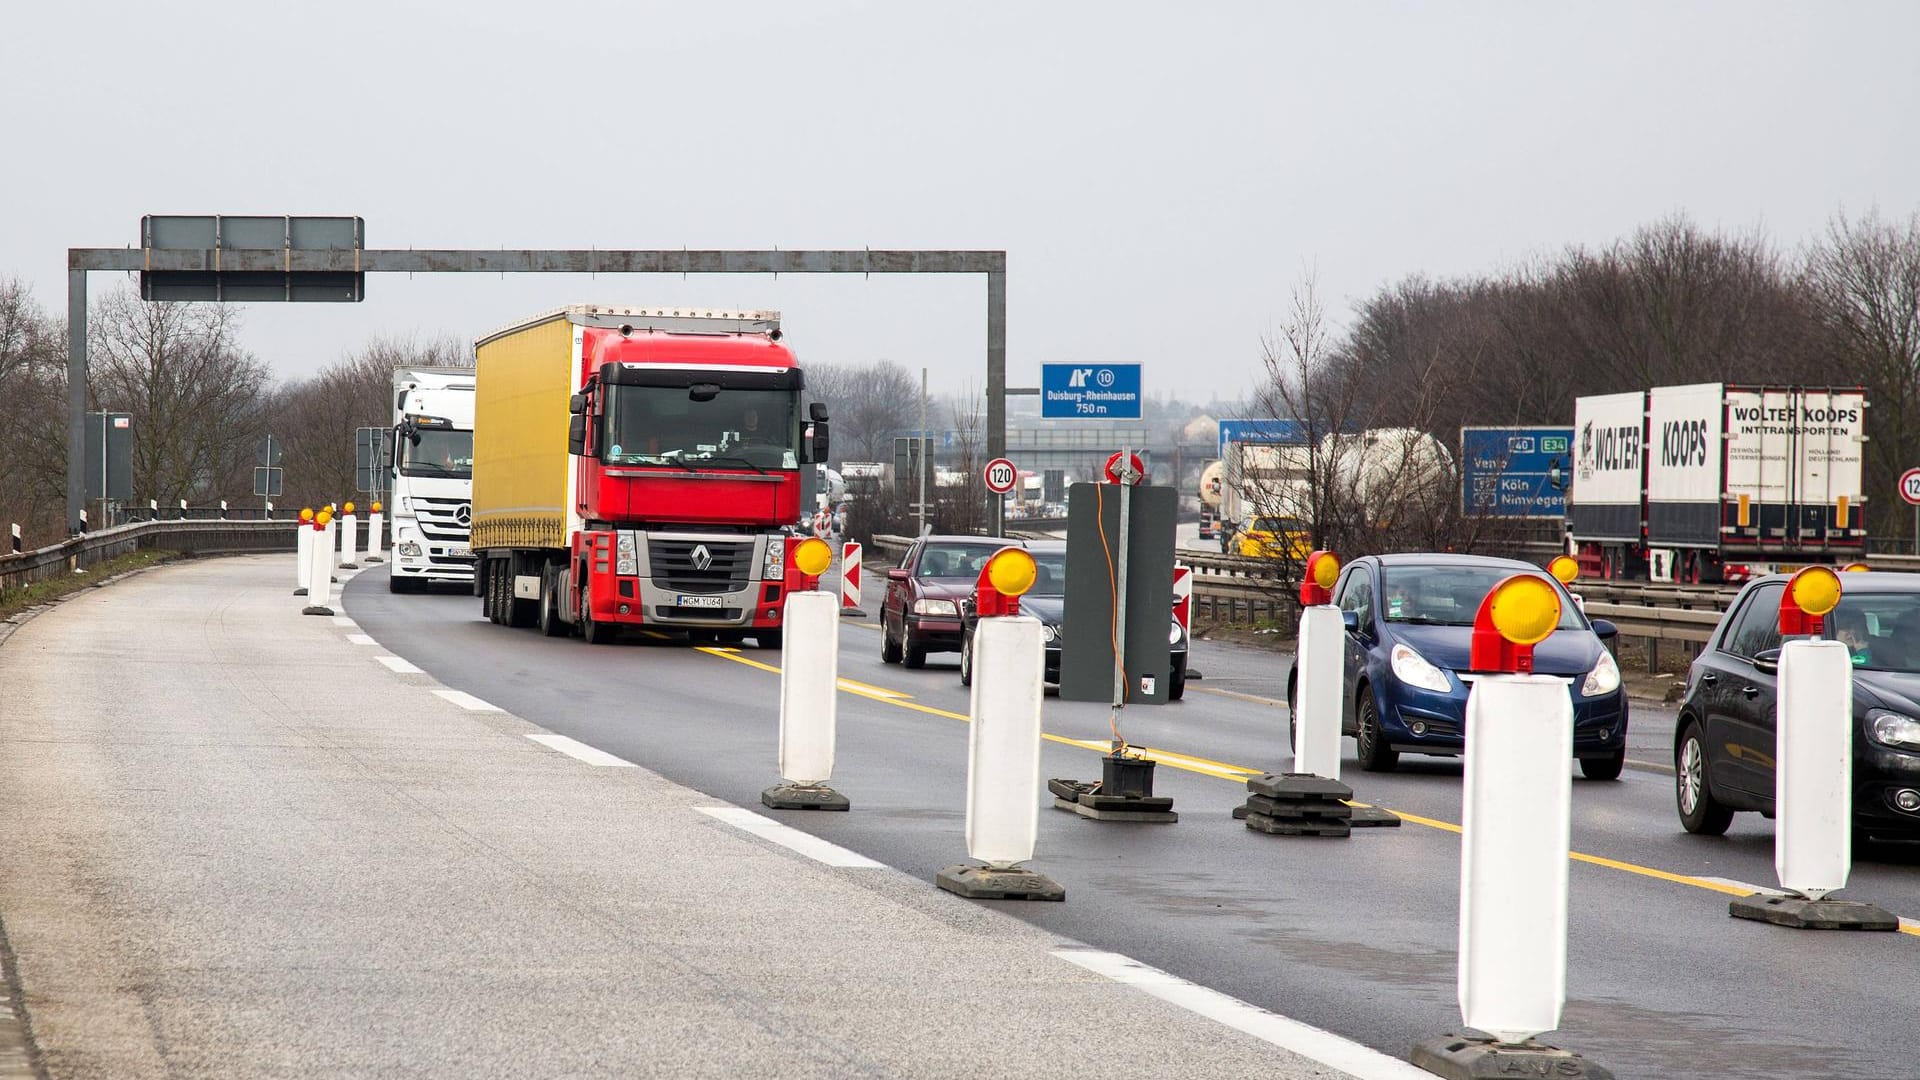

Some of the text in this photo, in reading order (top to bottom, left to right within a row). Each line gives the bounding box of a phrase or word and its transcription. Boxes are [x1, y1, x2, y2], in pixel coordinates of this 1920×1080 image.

[1100, 373, 1111, 383] 10
[1047, 390, 1136, 403] Duisburg-Rheinhausen
[1076, 404, 1107, 414] 750 m
[1735, 407, 1858, 423] WOLTER KOOPS
[1543, 440, 1564, 450] E34
[1595, 426, 1640, 471] WOLTER
[1662, 418, 1707, 467] KOOPS
[1474, 457, 1508, 469] Veno
[992, 468, 1011, 483] 120
[1501, 479, 1529, 491] Köln
[1907, 479, 1920, 494] 12
[1501, 493, 1567, 508] Nimwegen
[1501, 1060, 1582, 1077] AVS
